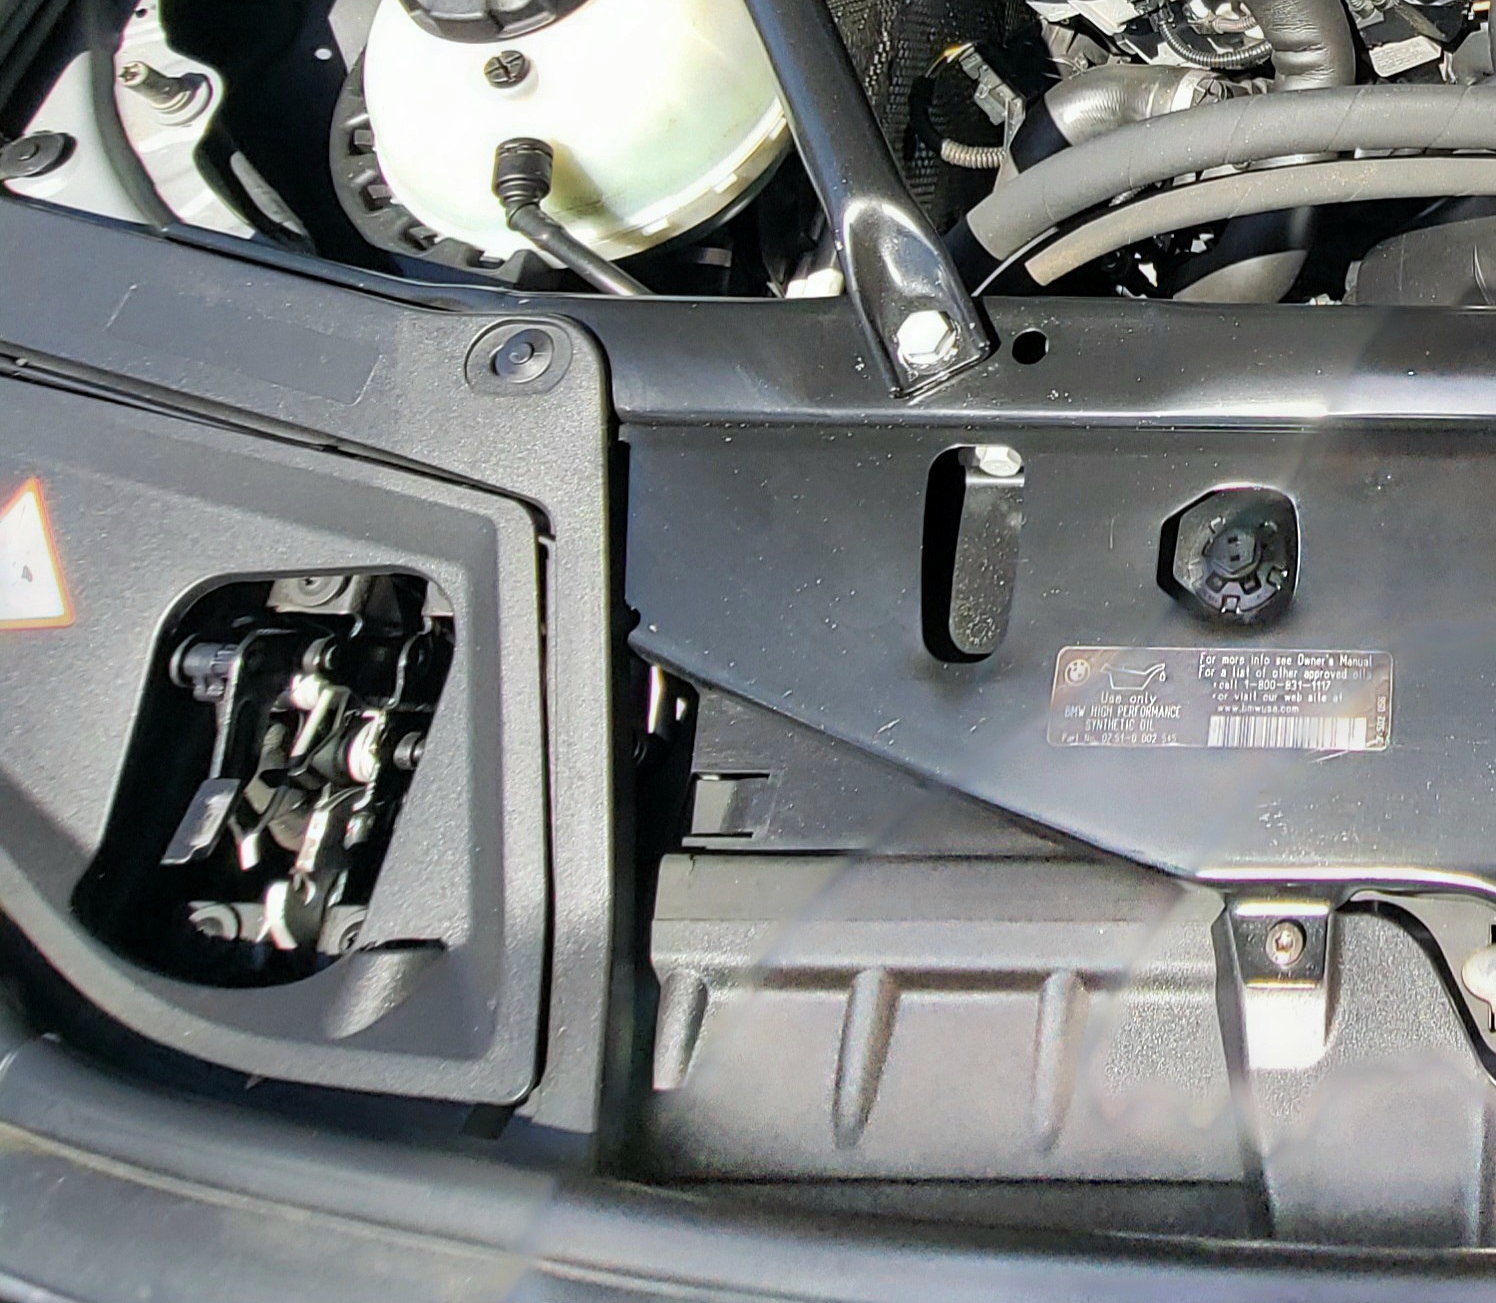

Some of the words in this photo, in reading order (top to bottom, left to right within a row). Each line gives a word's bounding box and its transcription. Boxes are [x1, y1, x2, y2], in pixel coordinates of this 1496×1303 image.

[1200, 652, 1217, 665] For
[1221, 654, 1245, 666] more
[1251, 654, 1270, 666] info
[1276, 656, 1292, 666] see
[1297, 653, 1334, 666] Owner's
[1339, 654, 1373, 666] Manual
[1198, 664, 1215, 678] For
[1220, 668, 1227, 678] a
[1232, 666, 1249, 678] list
[1256, 666, 1267, 678] of
[1272, 666, 1298, 678] other
[1303, 667, 1347, 682] approved
[1244, 680, 1332, 691] 1-800-831-1117
[1100, 691, 1123, 703] Use
[1129, 691, 1157, 705] only
[1234, 692, 1257, 702] visit
[1262, 693, 1278, 702] our
[1284, 692, 1303, 702] web
[1307, 692, 1327, 702] site
[1064, 704, 1086, 718] BMW
[1090, 705, 1113, 718] HIGH
[1117, 705, 1182, 719] PERFORMANCE
[1217, 704, 1300, 714] www.bmwusa.com
[1085, 718, 1135, 731] SYNTHETIC
[1139, 718, 1154, 731] OIL
